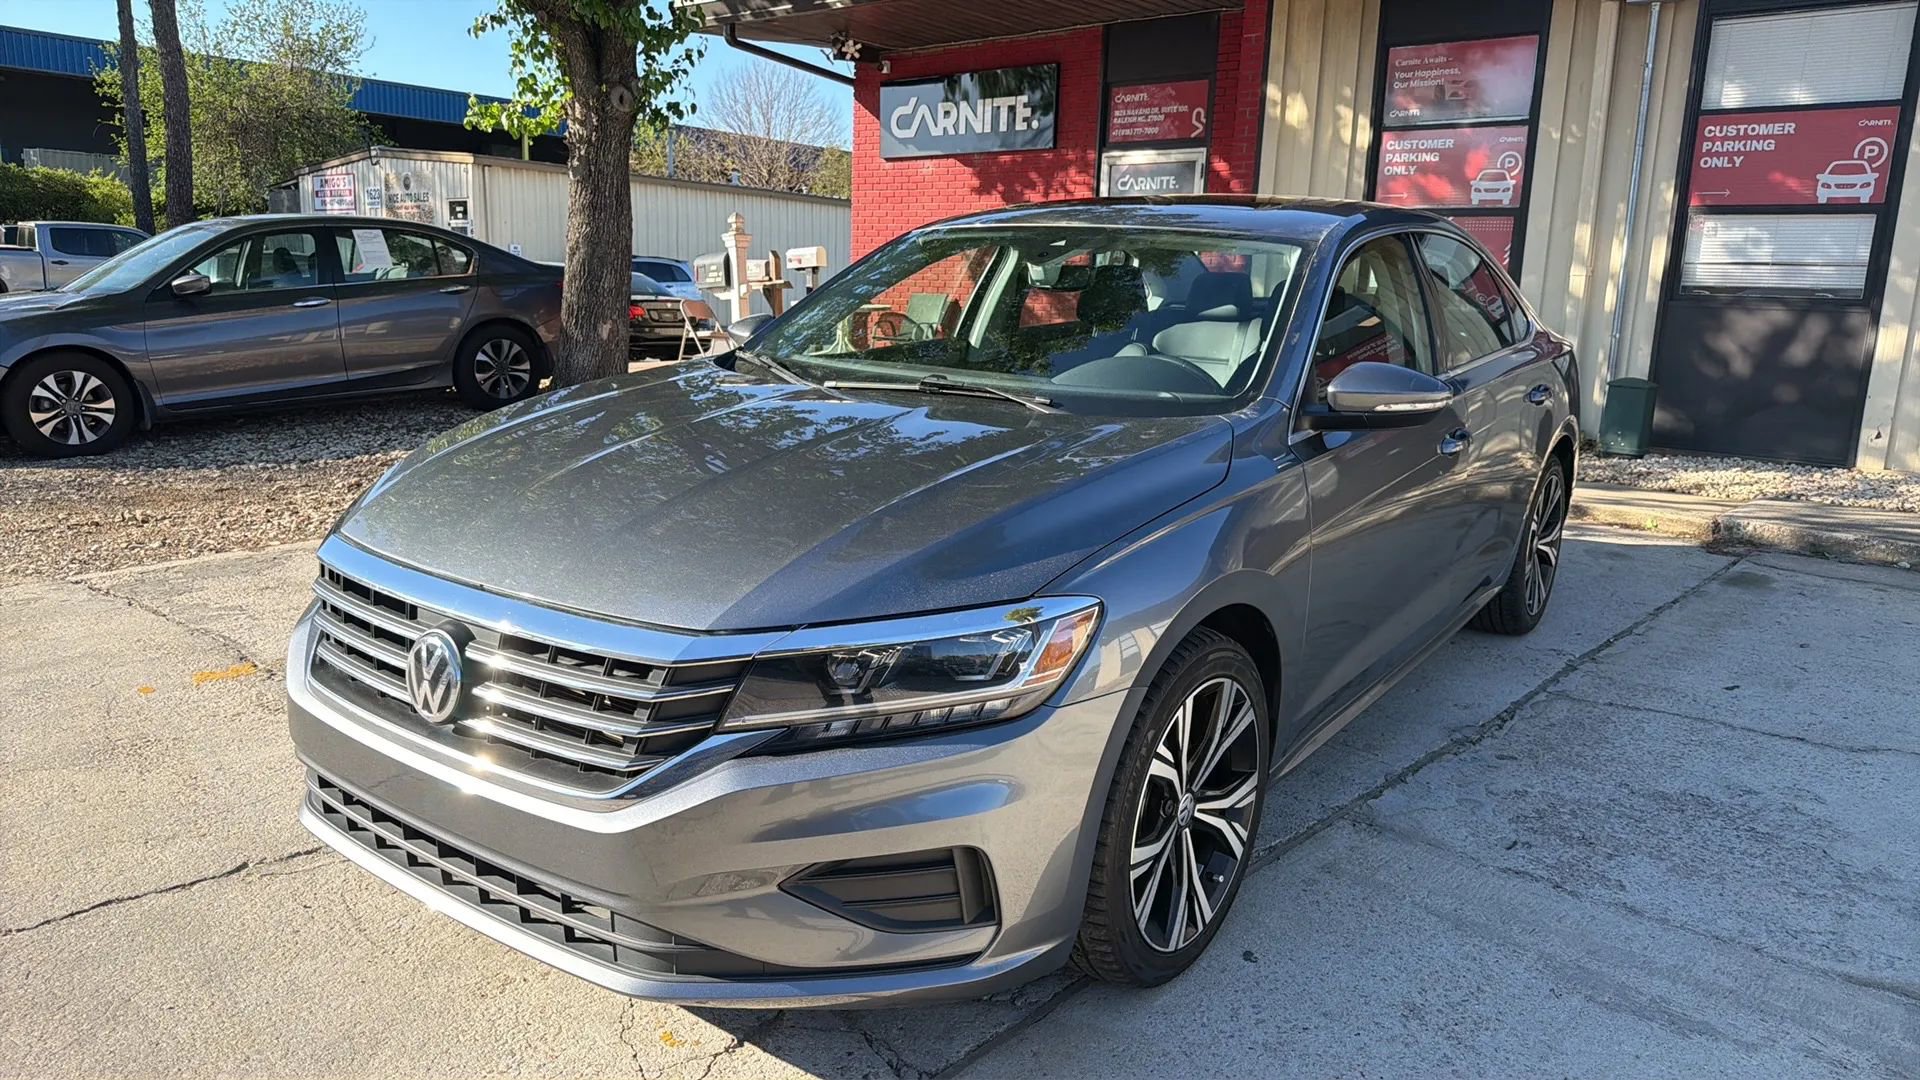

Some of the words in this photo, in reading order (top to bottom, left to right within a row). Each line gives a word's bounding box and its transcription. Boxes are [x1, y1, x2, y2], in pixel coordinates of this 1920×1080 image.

[1395, 57, 1422, 67] Carnite
[1423, 56, 1447, 65] Awaits
[1394, 71, 1414, 80] Your
[1393, 81, 1409, 89] Our
[1410, 78, 1445, 88] Mission!
[1703, 122, 1796, 137] CUSTOMER
[1386, 139, 1455, 150] CUSTOMER
[1702, 139, 1776, 153] PARKING
[1385, 152, 1440, 163] PARKING
[1700, 156, 1744, 168] ONLY
[1384, 165, 1417, 175] ONLY
[319, 177, 347, 188] AMIGO'S
[414, 192, 430, 202] SALES
